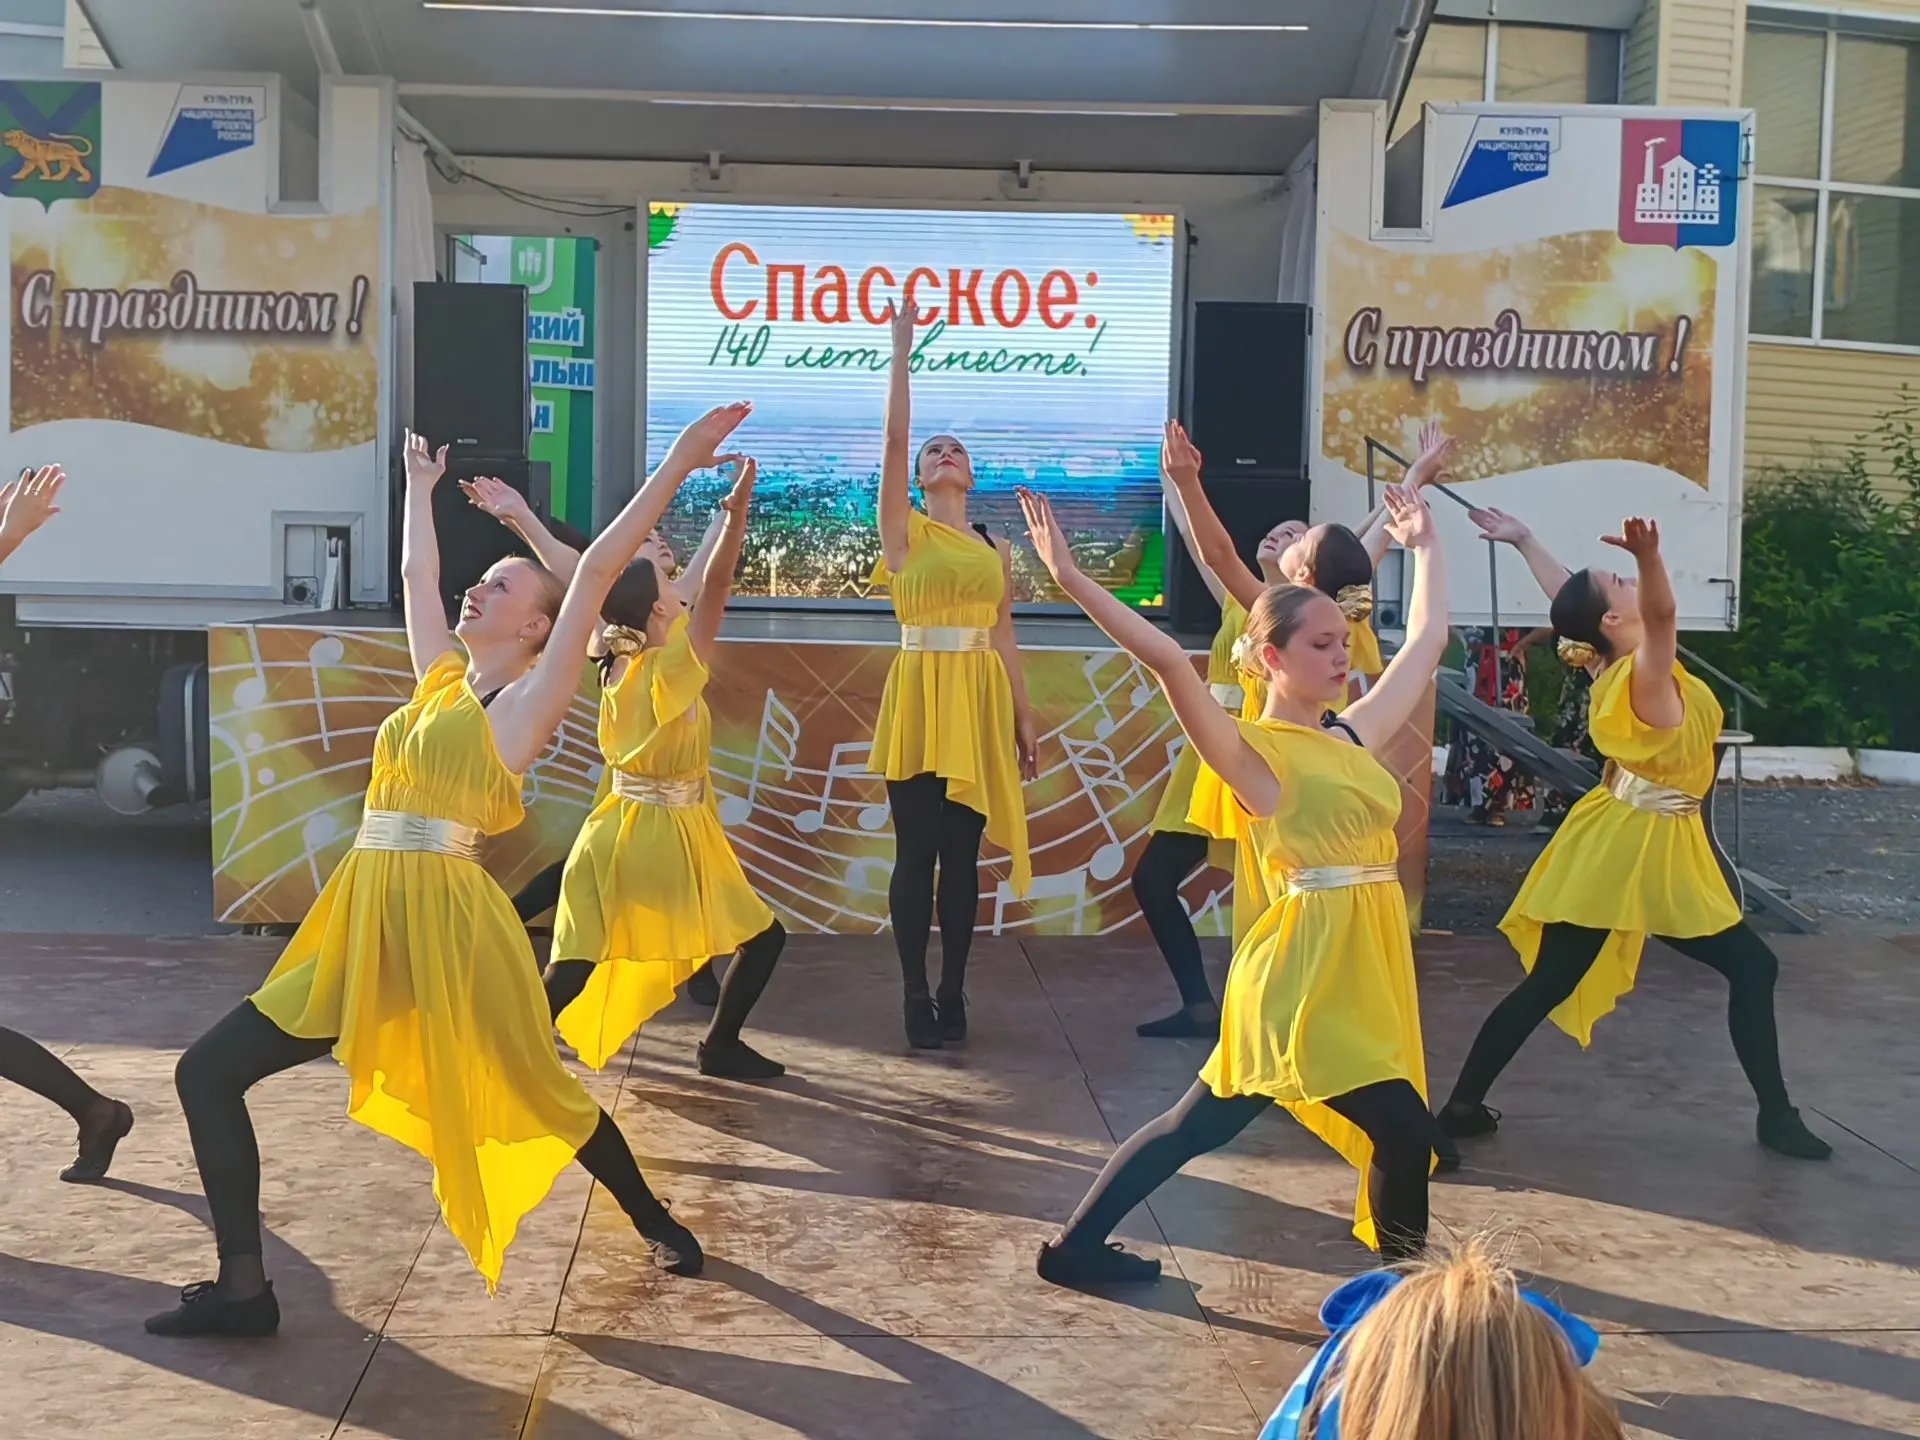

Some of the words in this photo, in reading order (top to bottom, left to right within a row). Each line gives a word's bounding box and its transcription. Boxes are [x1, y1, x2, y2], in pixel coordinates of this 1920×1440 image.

[203, 94, 254, 105] КУЛЬТУРА
[1499, 126, 1549, 136] КУЛЬТУРА
[1477, 141, 1548, 152] НАЦИОНАЛЬНЫЕ
[1507, 151, 1548, 162] ПРОЕКТЫ
[1512, 162, 1548, 172] РОССИИ
[709, 241, 1100, 329] Спасское:
[21, 271, 54, 330] С
[1346, 309, 1381, 367] С
[708, 323, 771, 367] 140
[785, 344, 892, 371] лет
[908, 319, 1107, 377] вместе!
